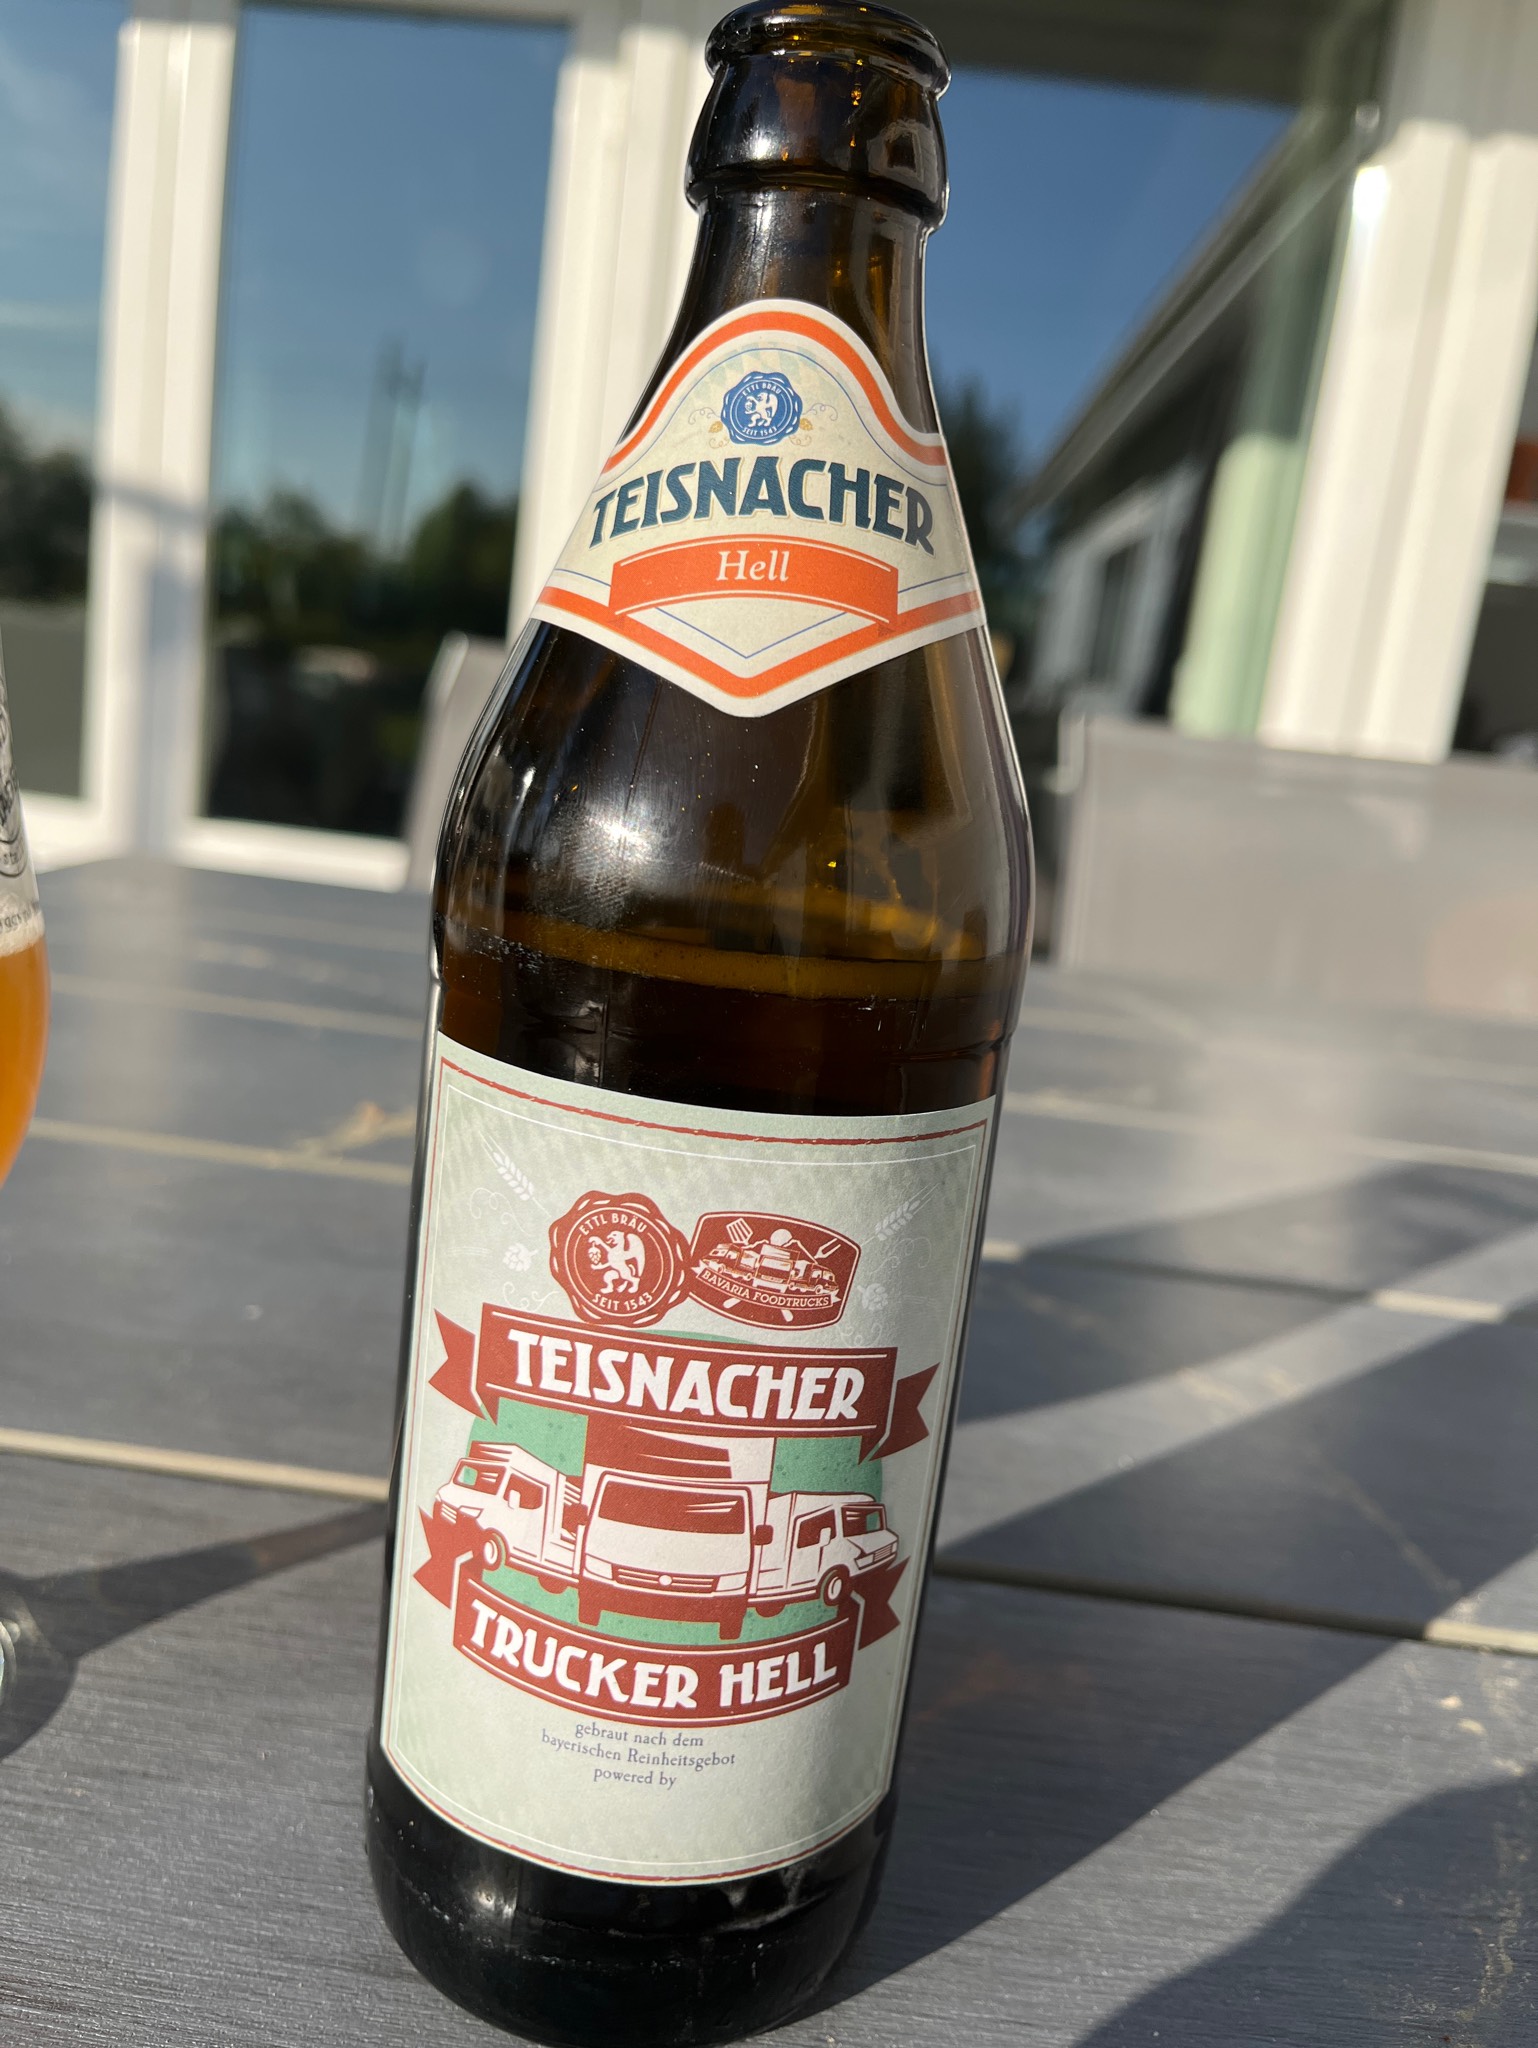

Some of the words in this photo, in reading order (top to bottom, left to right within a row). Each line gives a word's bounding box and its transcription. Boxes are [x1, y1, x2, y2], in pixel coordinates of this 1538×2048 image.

[742, 427, 758, 436] SEIT
[760, 426, 777, 436] 1543
[588, 455, 935, 556] TEISNACHER
[716, 550, 789, 582] Hell
[579, 1214, 607, 1235] ETTL
[611, 1212, 647, 1233] BRÄU
[592, 1293, 620, 1311] SEIT
[624, 1291, 653, 1311] 1543
[702, 1270, 750, 1299] BAVARIA
[753, 1292, 829, 1307] FOODTRUCKS
[507, 1328, 866, 1421] TEISNACHER
[471, 1600, 699, 1710] TRUCKER
[719, 1641, 838, 1708] HELL
[541, 1729, 621, 1761] bayerischen
[627, 1748, 736, 1772] Reinheitsgebot
[575, 1722, 629, 1742] gebraut
[634, 1731, 667, 1746] nach
[672, 1733, 704, 1747] dem
[593, 1768, 653, 1785] powered
[659, 1771, 677, 1791] by
